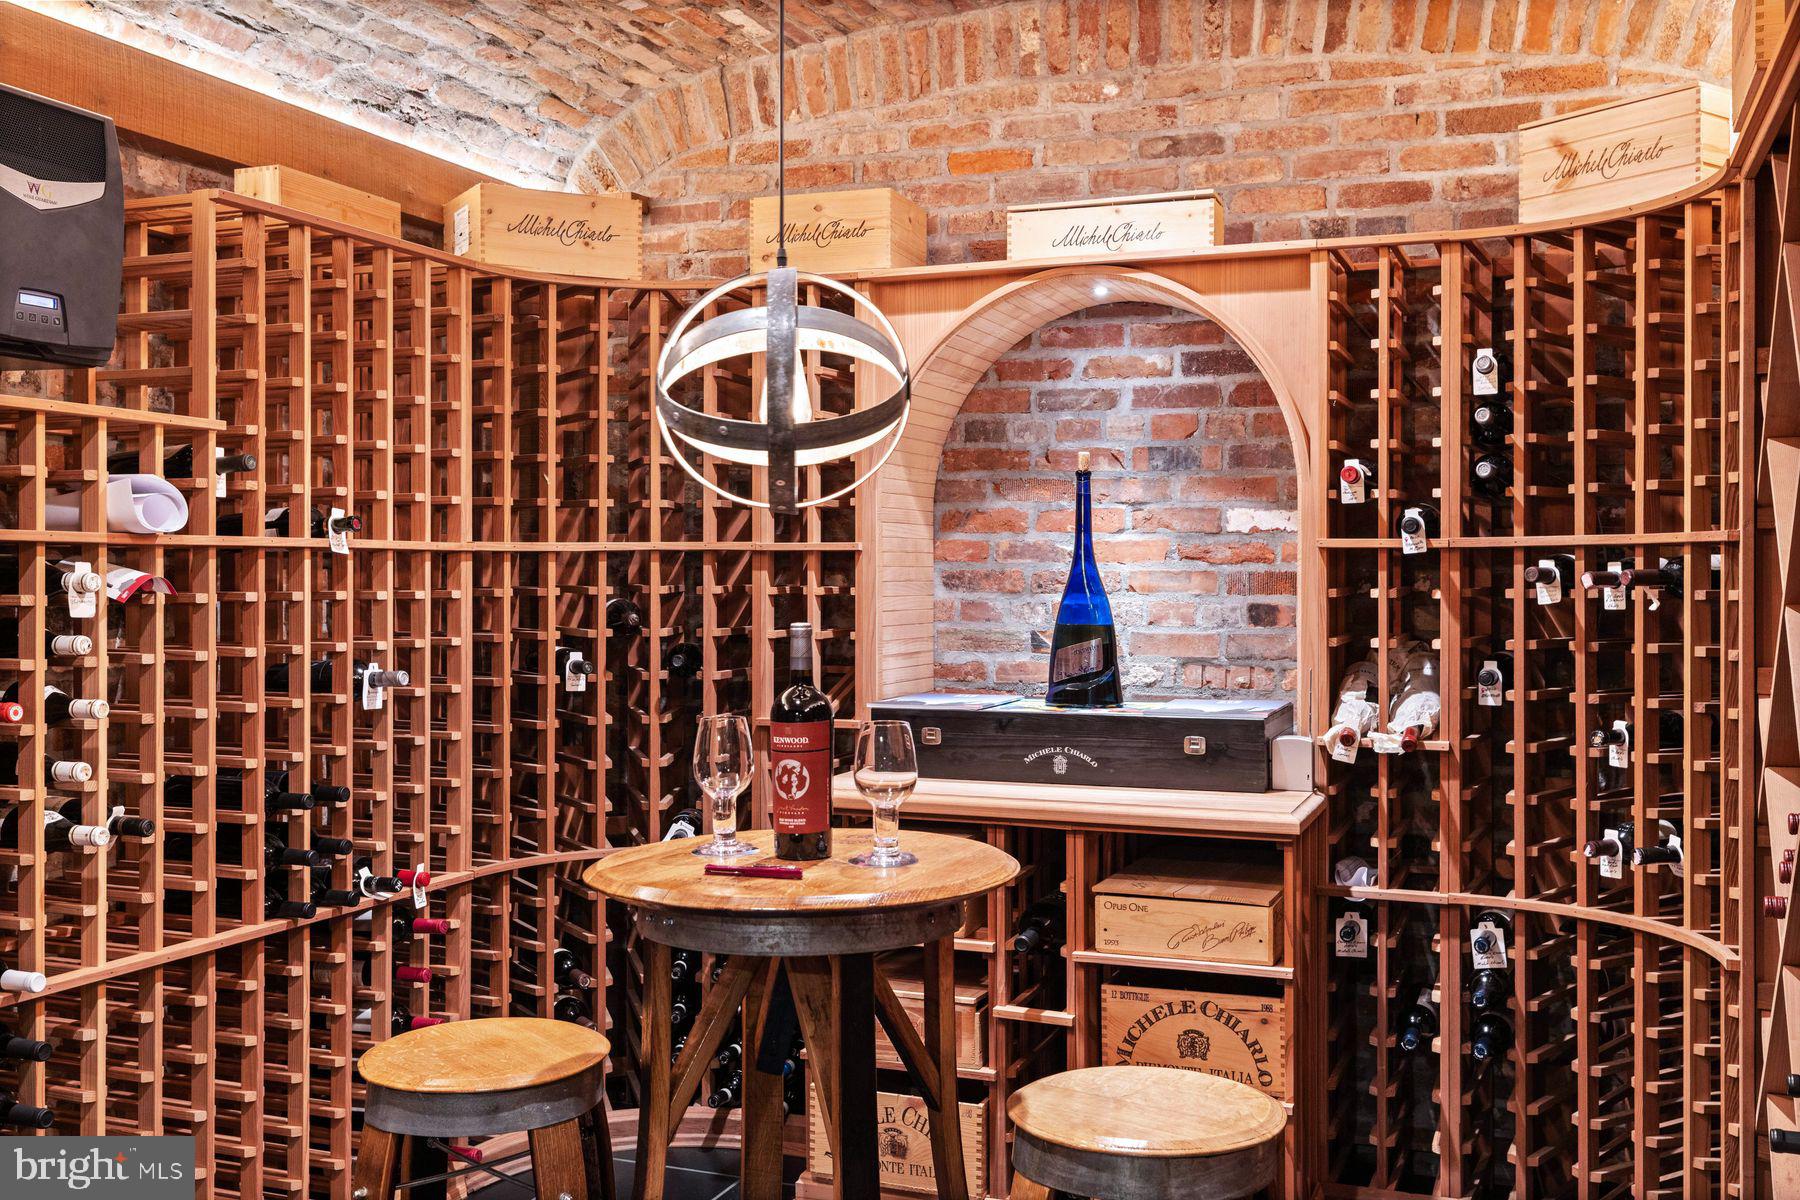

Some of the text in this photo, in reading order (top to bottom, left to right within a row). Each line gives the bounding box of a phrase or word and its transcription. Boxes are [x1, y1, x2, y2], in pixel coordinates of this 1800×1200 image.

[1023, 746, 1098, 768] MICHELE CHIARLO
[1111, 990, 1117, 999] 12
[1261, 1004, 1274, 1013] 1988
[1115, 1000, 1273, 1087] MICHELE CHIARLO
[909, 1163, 936, 1179] ITAL
